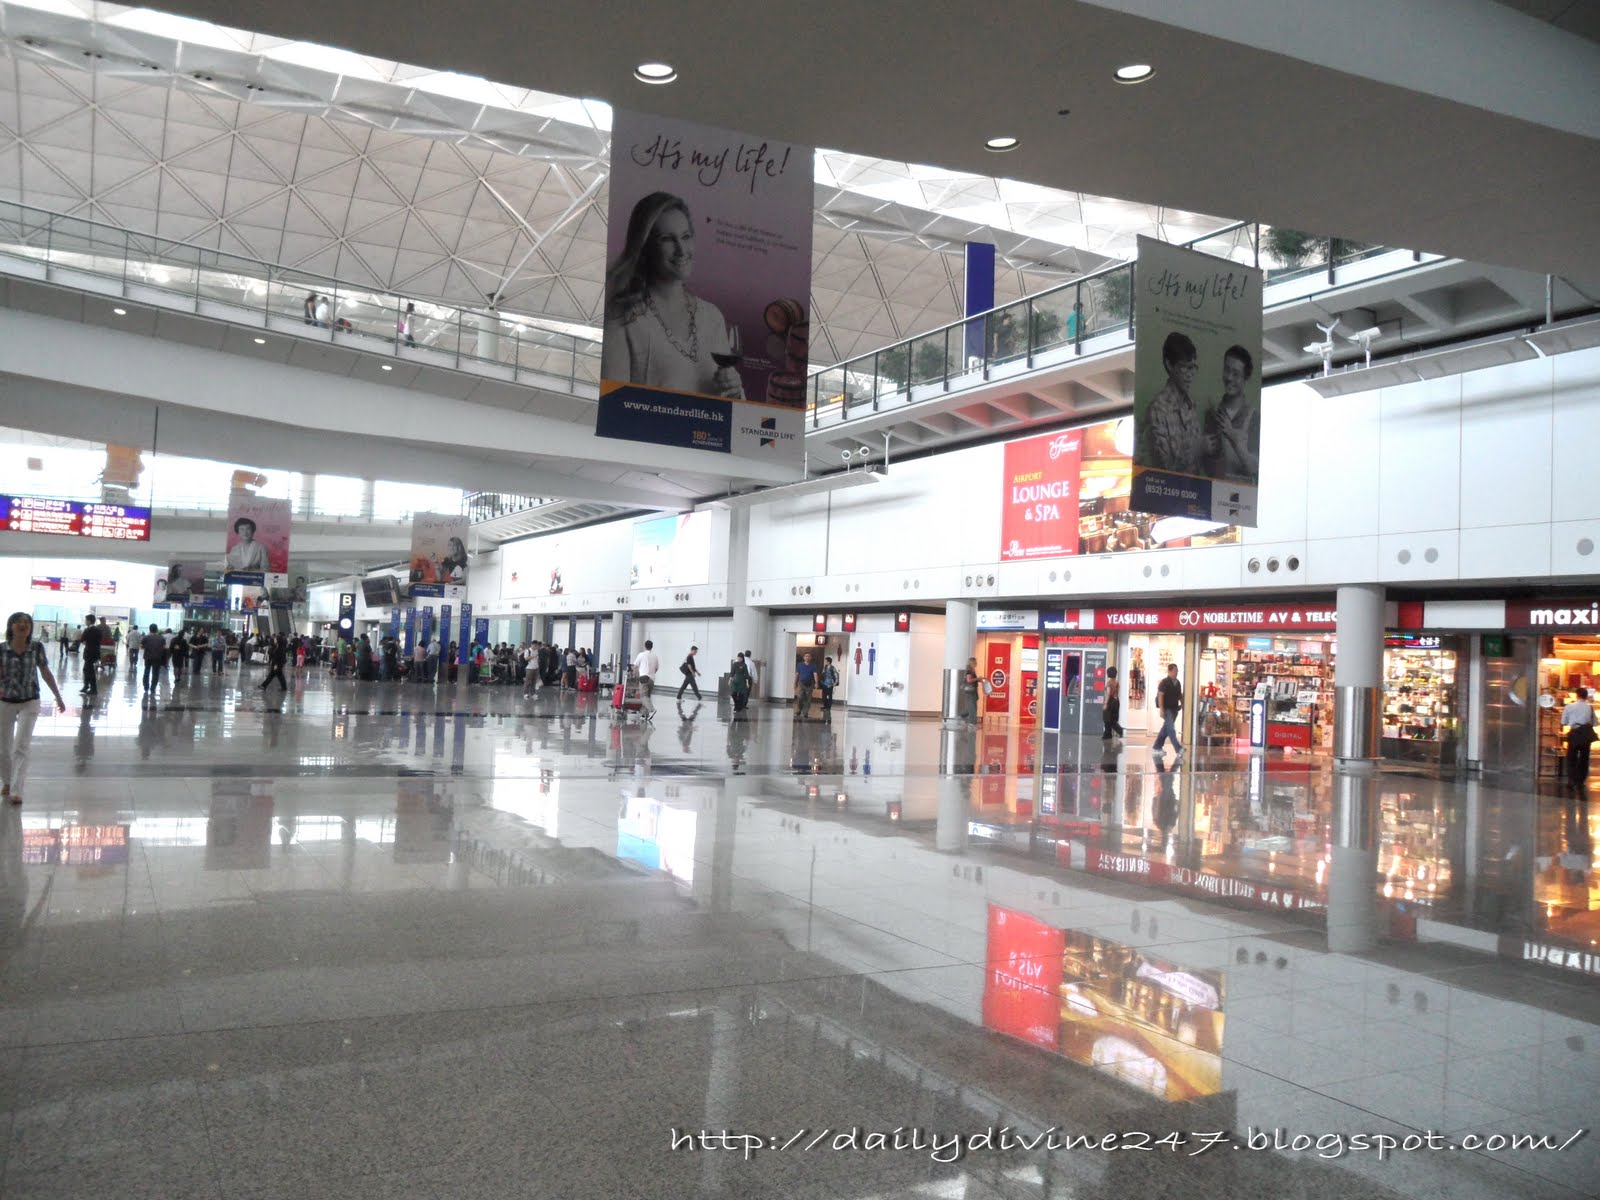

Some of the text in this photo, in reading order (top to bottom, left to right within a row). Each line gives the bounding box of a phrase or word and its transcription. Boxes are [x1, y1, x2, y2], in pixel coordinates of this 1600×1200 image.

[631, 135, 791, 194] It's my life!
[1149, 268, 1248, 315] It's my life!
[623, 400, 725, 423] www.standardlife.hk
[741, 426, 794, 440] STANDARD LIFE
[1013, 471, 1043, 484] AIRPORT
[1012, 480, 1070, 504] LOUNGE
[1145, 484, 1163, 496] (852)
[1163, 487, 1180, 497] 2169
[1024, 503, 1060, 522] & SPA
[342, 594, 352, 606] B
[1106, 613, 1145, 625] YEASUN
[1202, 611, 1264, 624] NOBLETIME
[1268, 611, 1288, 624] AV
[1291, 612, 1302, 623] &
[1530, 602, 1599, 625] maxi
[1274, 731, 1302, 740] DIGITAL
